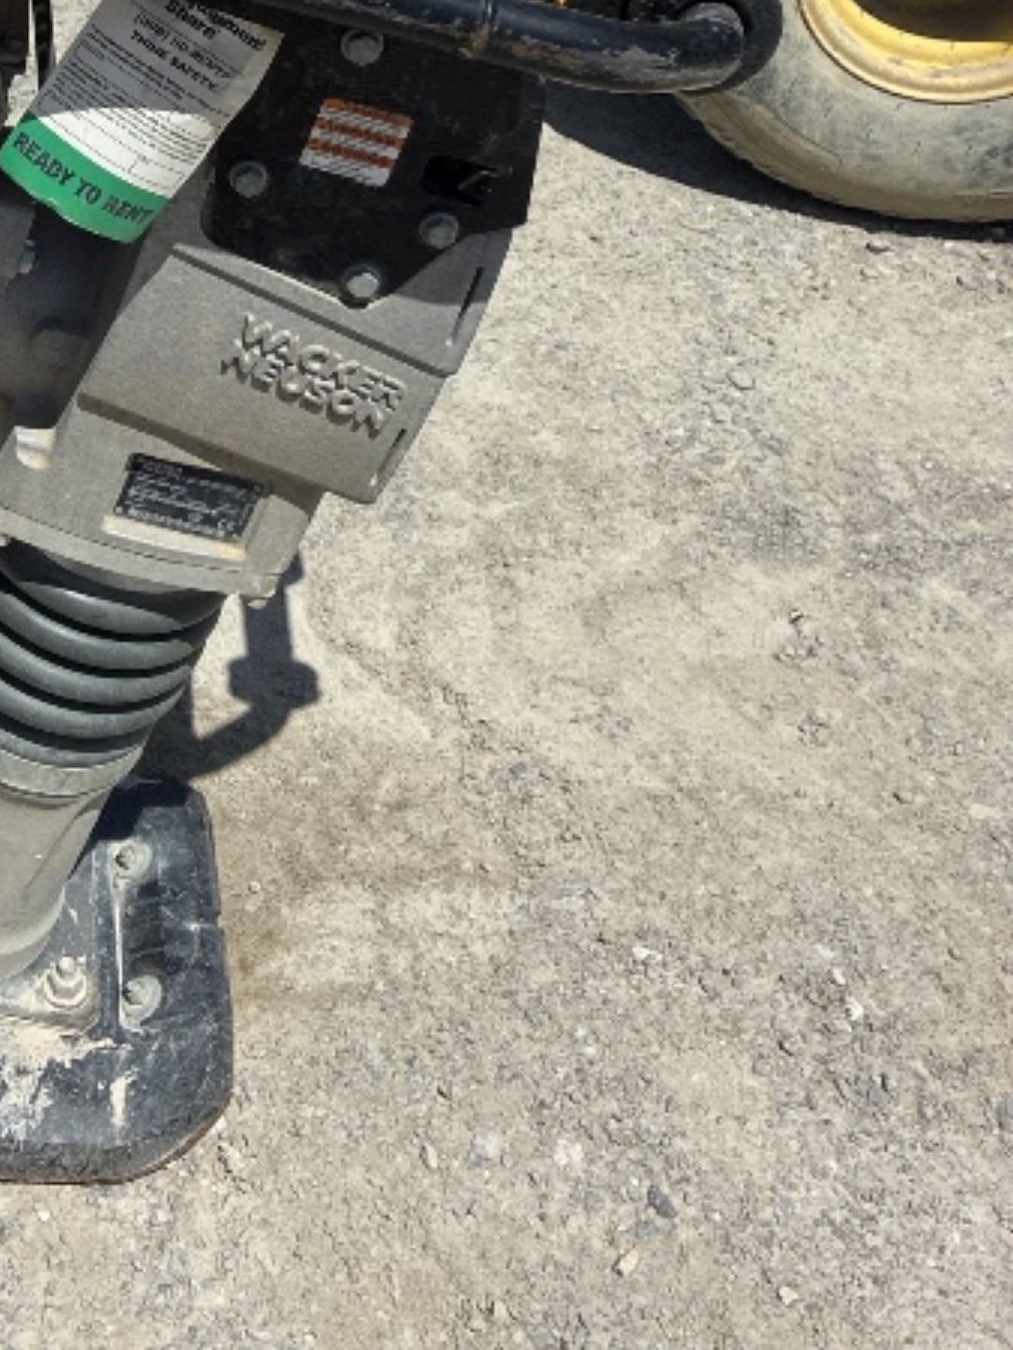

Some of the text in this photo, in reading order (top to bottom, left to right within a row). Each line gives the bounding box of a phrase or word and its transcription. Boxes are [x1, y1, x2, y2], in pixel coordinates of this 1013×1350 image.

[13, 131, 155, 223] READY TO RENT
[222, 338, 388, 440] NEUSON
[240, 312, 406, 412] WACKER
